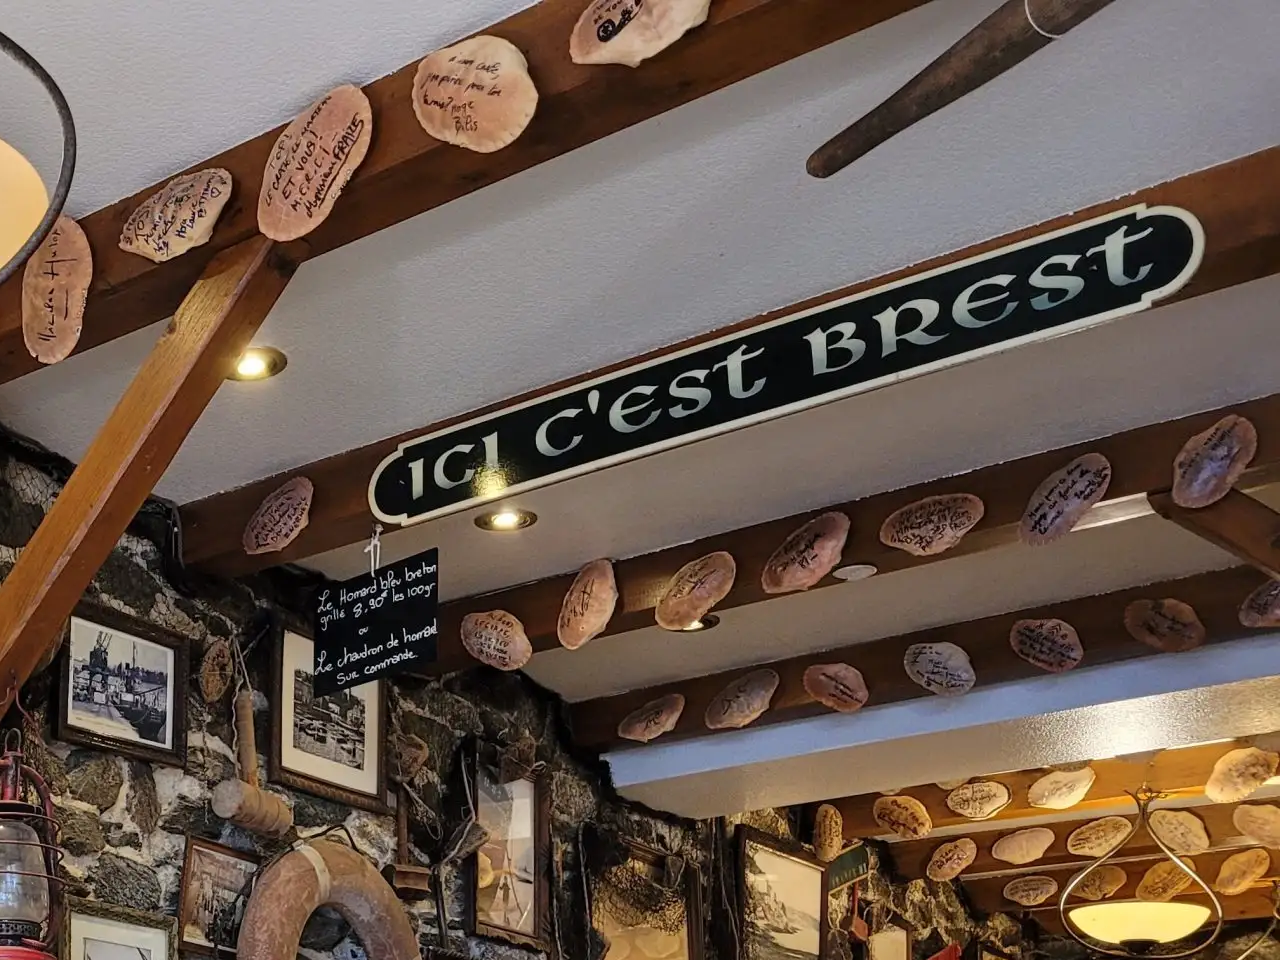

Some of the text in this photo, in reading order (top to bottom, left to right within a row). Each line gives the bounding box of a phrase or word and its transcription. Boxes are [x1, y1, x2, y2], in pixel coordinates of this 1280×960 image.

[282, 176, 296, 200] ET
[407, 221, 1157, 502] ICI C'EST BREST
[317, 562, 436, 613] Le Homard bleu breton
[392, 588, 405, 602] les
[406, 582, 436, 598] 100gr
[314, 618, 438, 676] Le chaudron de homard
[358, 626, 369, 636] ou
